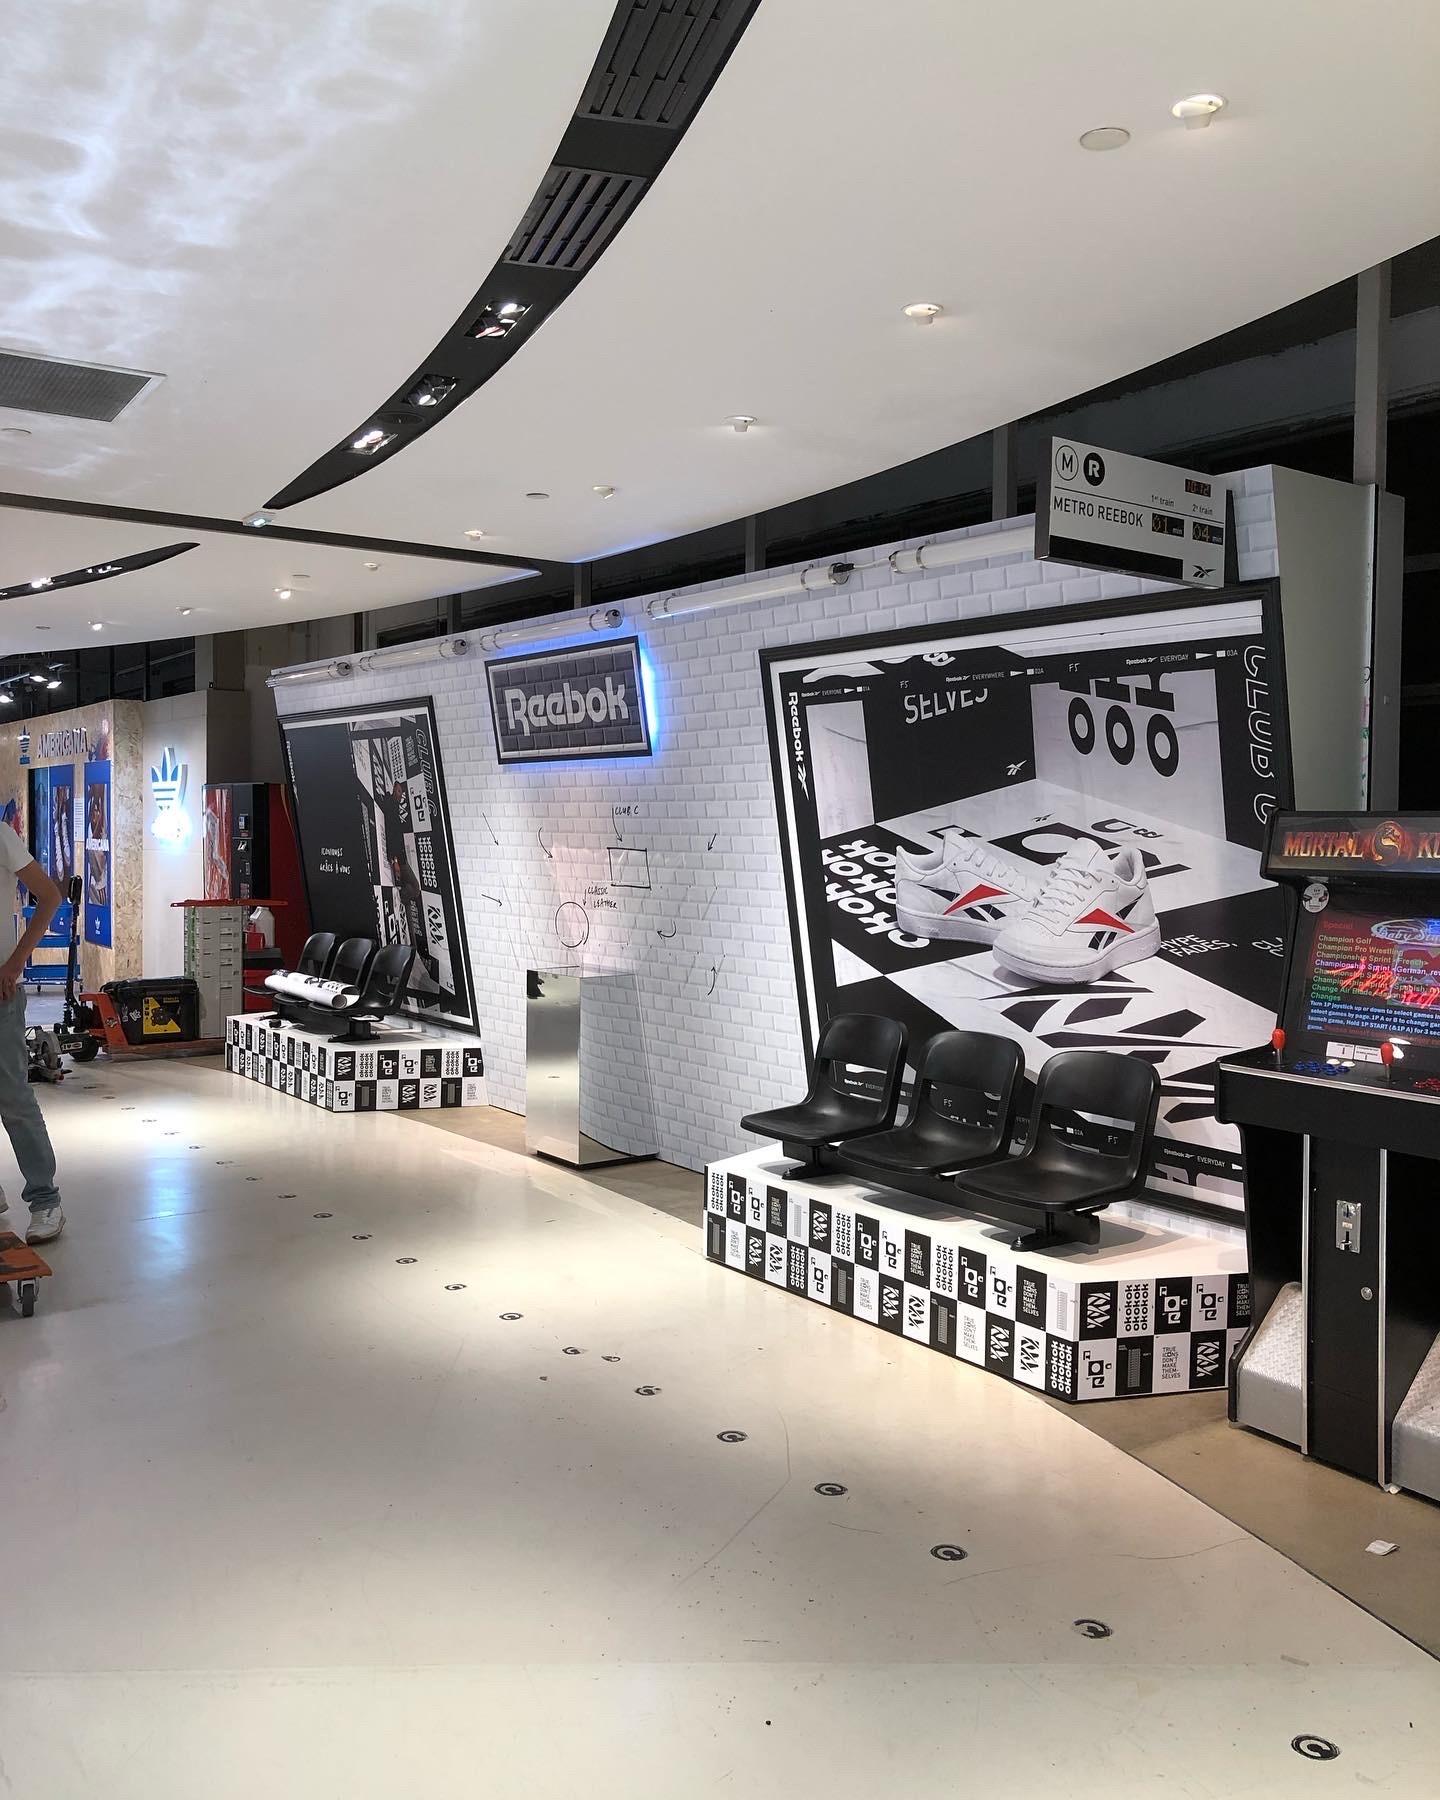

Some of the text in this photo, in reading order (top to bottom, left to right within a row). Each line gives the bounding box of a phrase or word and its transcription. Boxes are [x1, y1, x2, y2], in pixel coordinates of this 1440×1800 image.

[1160, 497, 1175, 508] train
[1054, 496, 1144, 528] METRO REEBOK
[1160, 654, 1189, 663] EVERYDAY
[972, 671, 1005, 681] EVERYWHERE
[822, 688, 842, 696] EVERYONE
[504, 676, 630, 737] Reebok
[787, 692, 804, 762] Reebok
[615, 806, 631, 815] CLUB
[1282, 831, 1364, 858] MORTAL
[588, 886, 608, 895] CLASSIC
[593, 900, 617, 909] LEATHER
[1318, 934, 1372, 945] Champion Golf
[1317, 943, 1353, 953] Champion
[1355, 945, 1367, 953] Pro
[1316, 951, 1367, 961] Championship
[1369, 954, 1391, 964] Sprint
[1315, 959, 1366, 970] Championship
[1368, 963, 1390, 972] Sprint
[1312, 983, 1338, 993] Change
[1310, 991, 1341, 1001] Changes
[1406, 1019, 1428, 1027] change
[1197, 1156, 1226, 1168] EVERYDAY
